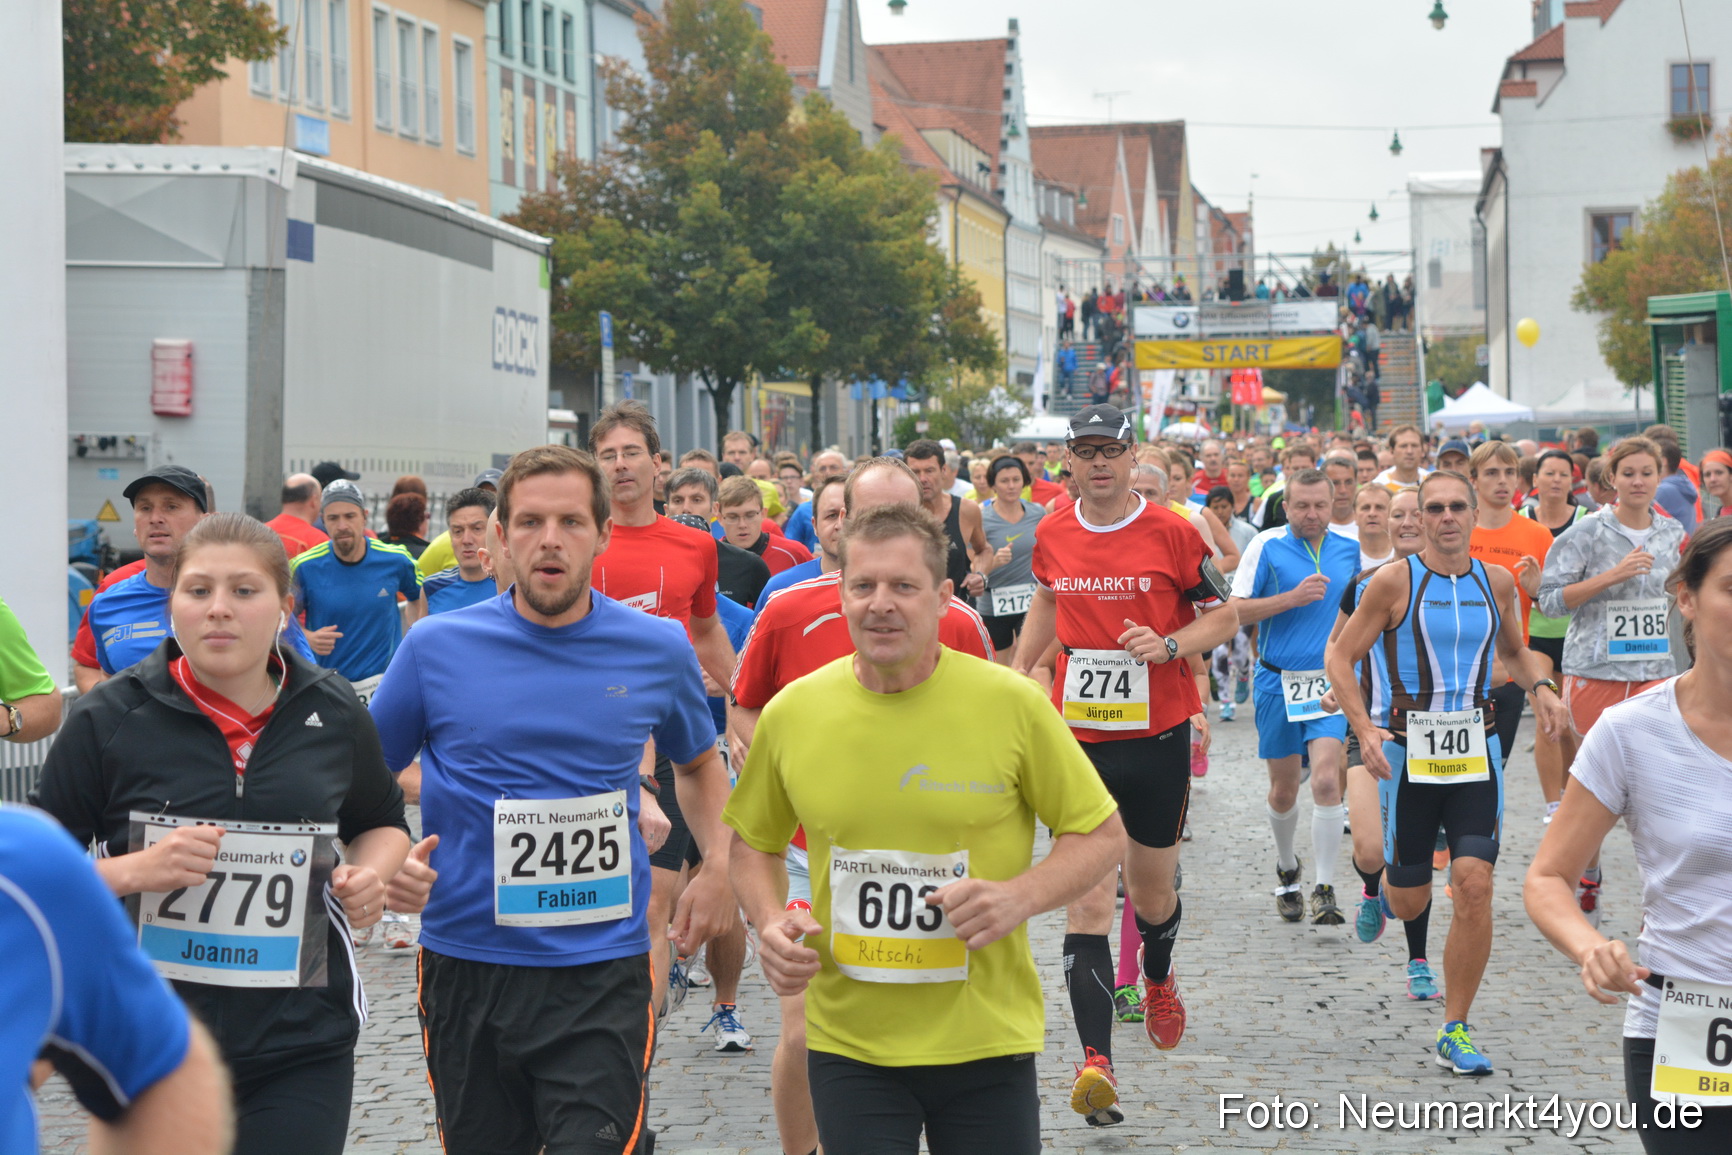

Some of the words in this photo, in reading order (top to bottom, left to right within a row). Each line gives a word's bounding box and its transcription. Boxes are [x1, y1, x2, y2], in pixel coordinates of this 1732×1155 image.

[492, 306, 539, 377] BOCK
[1202, 343, 1273, 363] START
[1053, 576, 1135, 591] NEUMARKT
[1614, 613, 1666, 637] 2185
[1625, 642, 1658, 652] Daniela
[1069, 657, 1091, 666] PARTL
[1091, 658, 1133, 667] Neumarkt
[1079, 669, 1132, 699] 274
[1086, 707, 1123, 721] Jürgen
[1408, 718, 1435, 726] PARTL
[1436, 717, 1471, 726] Neumarkt
[1424, 728, 1470, 755] 140
[1427, 762, 1468, 774] Thomas
[919, 778, 966, 793] Ritschi
[498, 813, 545, 825] PARTL
[549, 807, 609, 824] Neumarkt
[510, 825, 620, 878] 2425
[833, 859, 878, 874] PARTL
[881, 863, 947, 878] Neumarkt
[501, 876, 507, 884] B
[157, 871, 294, 928] 2779
[537, 889, 597, 909] Fabian
[858, 881, 943, 932] 603
[146, 913, 153, 923] D
[181, 938, 259, 965] Joanna
[858, 939, 923, 964] Ritschi
[1665, 990, 1715, 1008] PARTL
[1660, 1055, 1667, 1064] D
[1698, 1075, 1730, 1093] Bia
[595, 1131, 622, 1142] adidas
